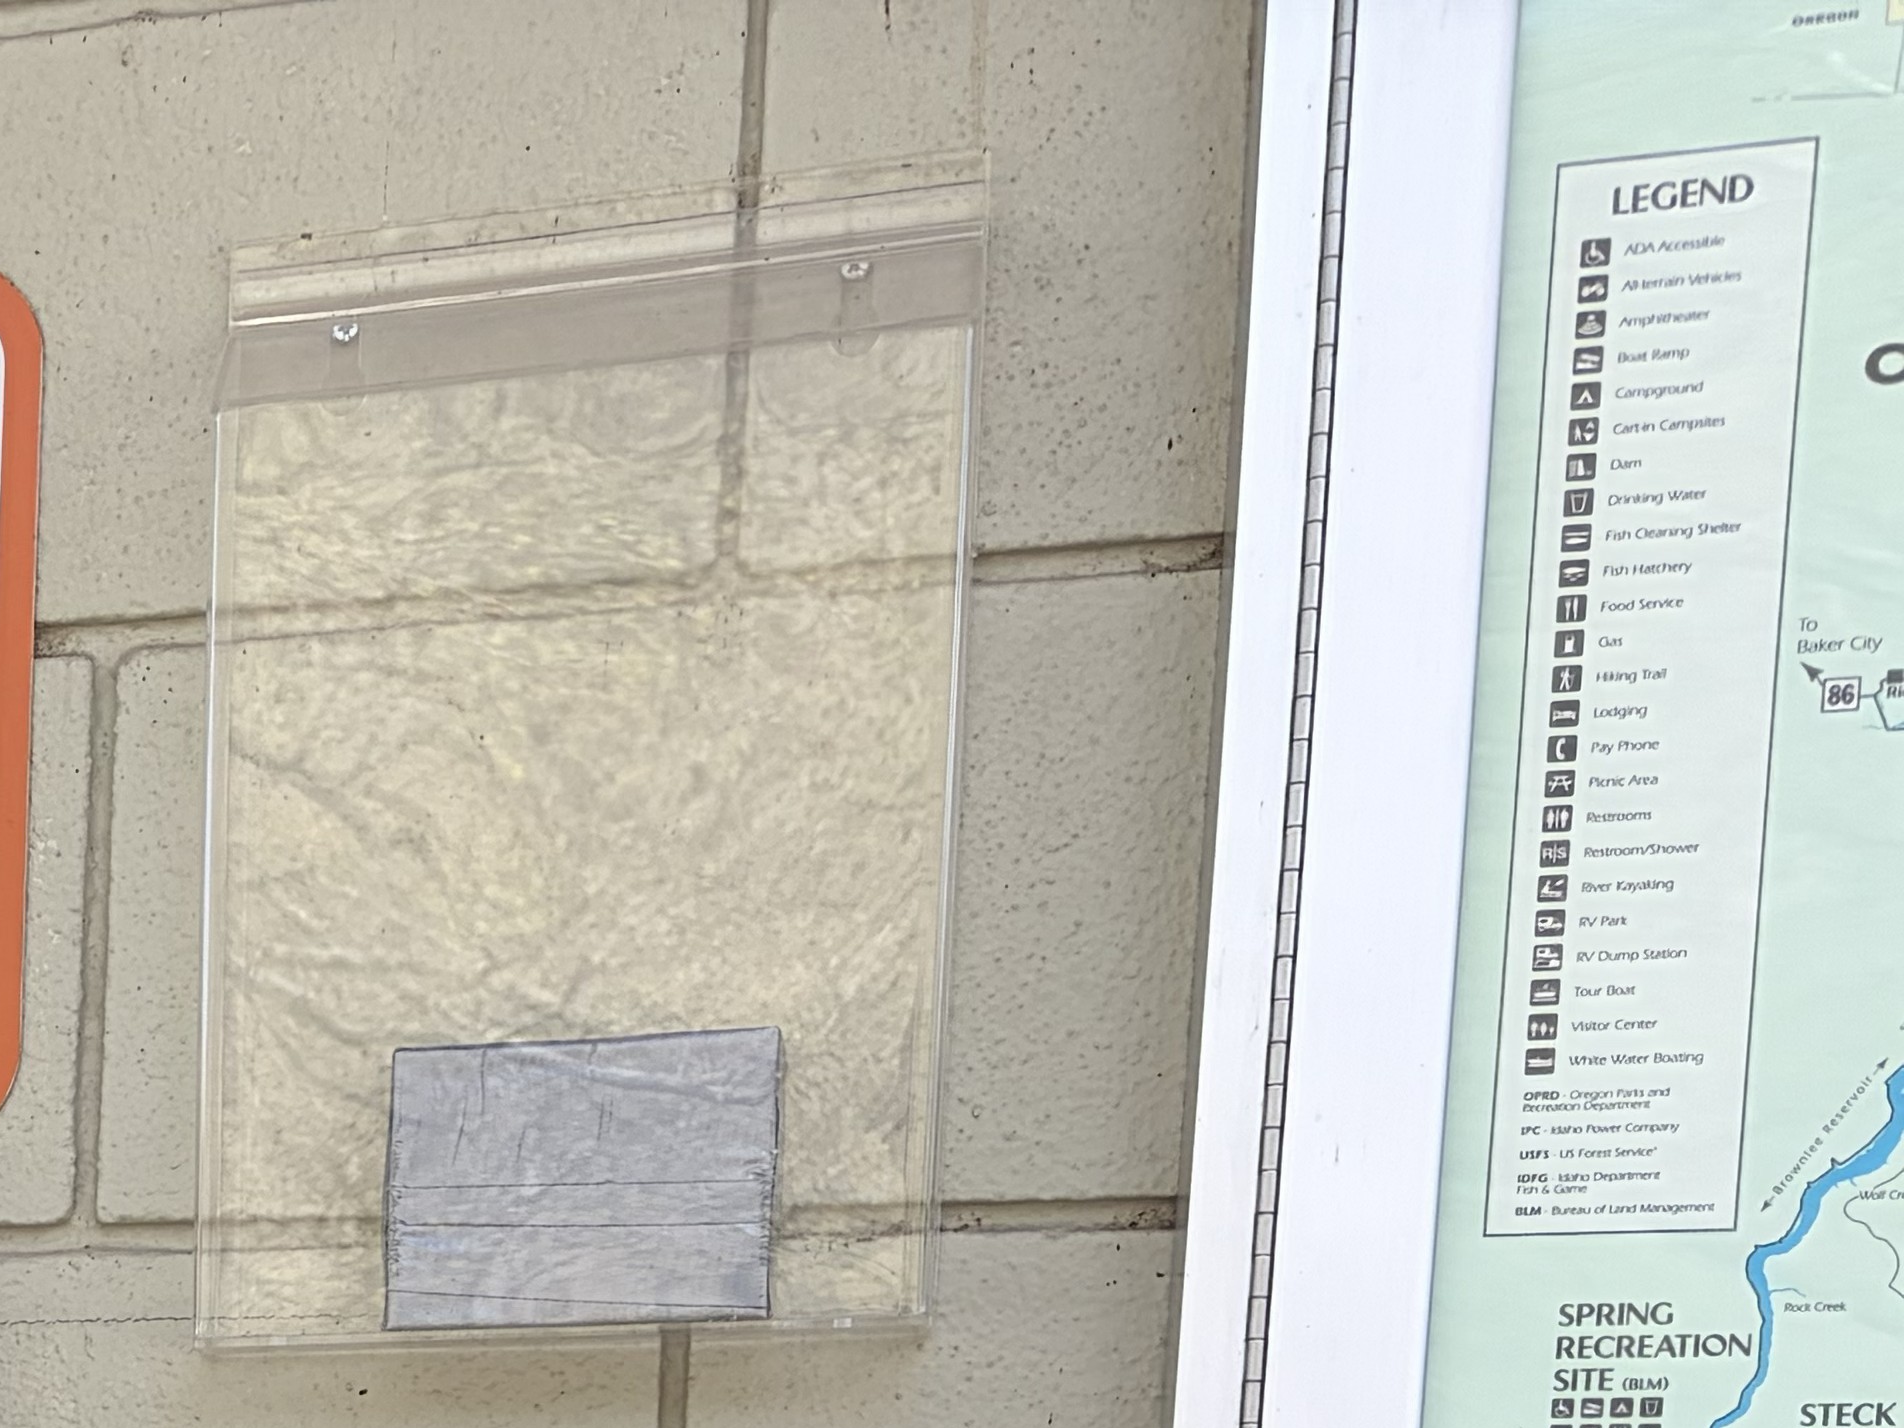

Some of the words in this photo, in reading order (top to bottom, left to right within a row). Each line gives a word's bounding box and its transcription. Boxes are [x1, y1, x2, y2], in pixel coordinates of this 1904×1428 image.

[1611, 173, 1754, 215] LEGEND
[1615, 381, 1704, 399] Campground
[1601, 600, 1634, 612] Food
[1639, 598, 1684, 610] Service
[1799, 617, 1818, 632] To
[1798, 639, 1843, 654] Baker
[1850, 635, 1883, 654] City
[1827, 684, 1855, 707] 86
[1558, 1302, 1674, 1326] SPRING
[1555, 1334, 1752, 1359] RECREATION
[1553, 1368, 1614, 1392] SITE
[1623, 1377, 1669, 1391] (BLM)
[1799, 1403, 1897, 1427] STECK
